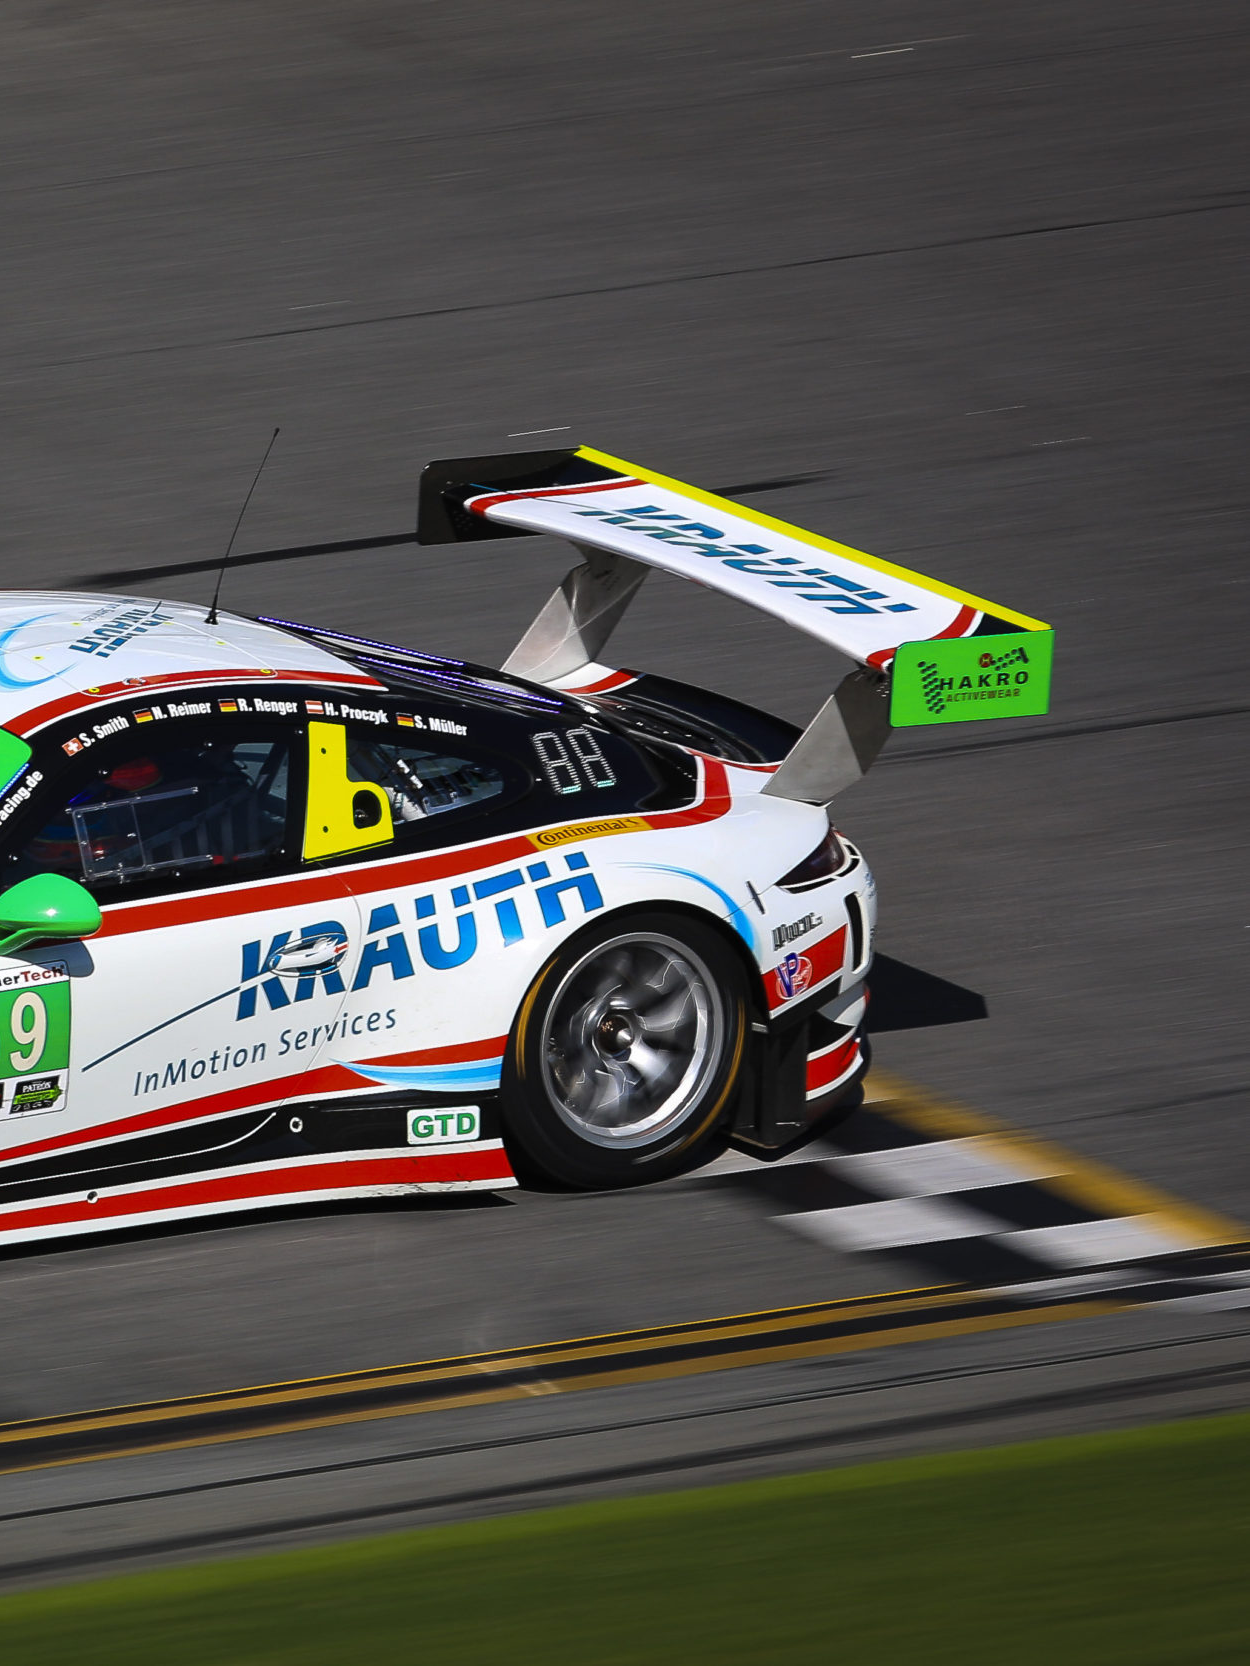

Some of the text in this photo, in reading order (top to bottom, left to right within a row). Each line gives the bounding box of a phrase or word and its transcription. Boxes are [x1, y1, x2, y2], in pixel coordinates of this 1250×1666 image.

[939, 671, 1029, 690] HAKRO
[946, 688, 1020, 702] ACTIVEWEAR
[152, 700, 211, 720] N. Reimer
[237, 699, 298, 715] R. Renger
[324, 703, 389, 724] H. Proczyk
[79, 715, 130, 748] S. Smith
[414, 715, 467, 735] S. Müller
[536, 819, 627, 846] Continental
[236, 851, 604, 1021] KRAUTH
[133, 1008, 396, 1096] InMotion Services
[411, 1112, 476, 1138] GTD
